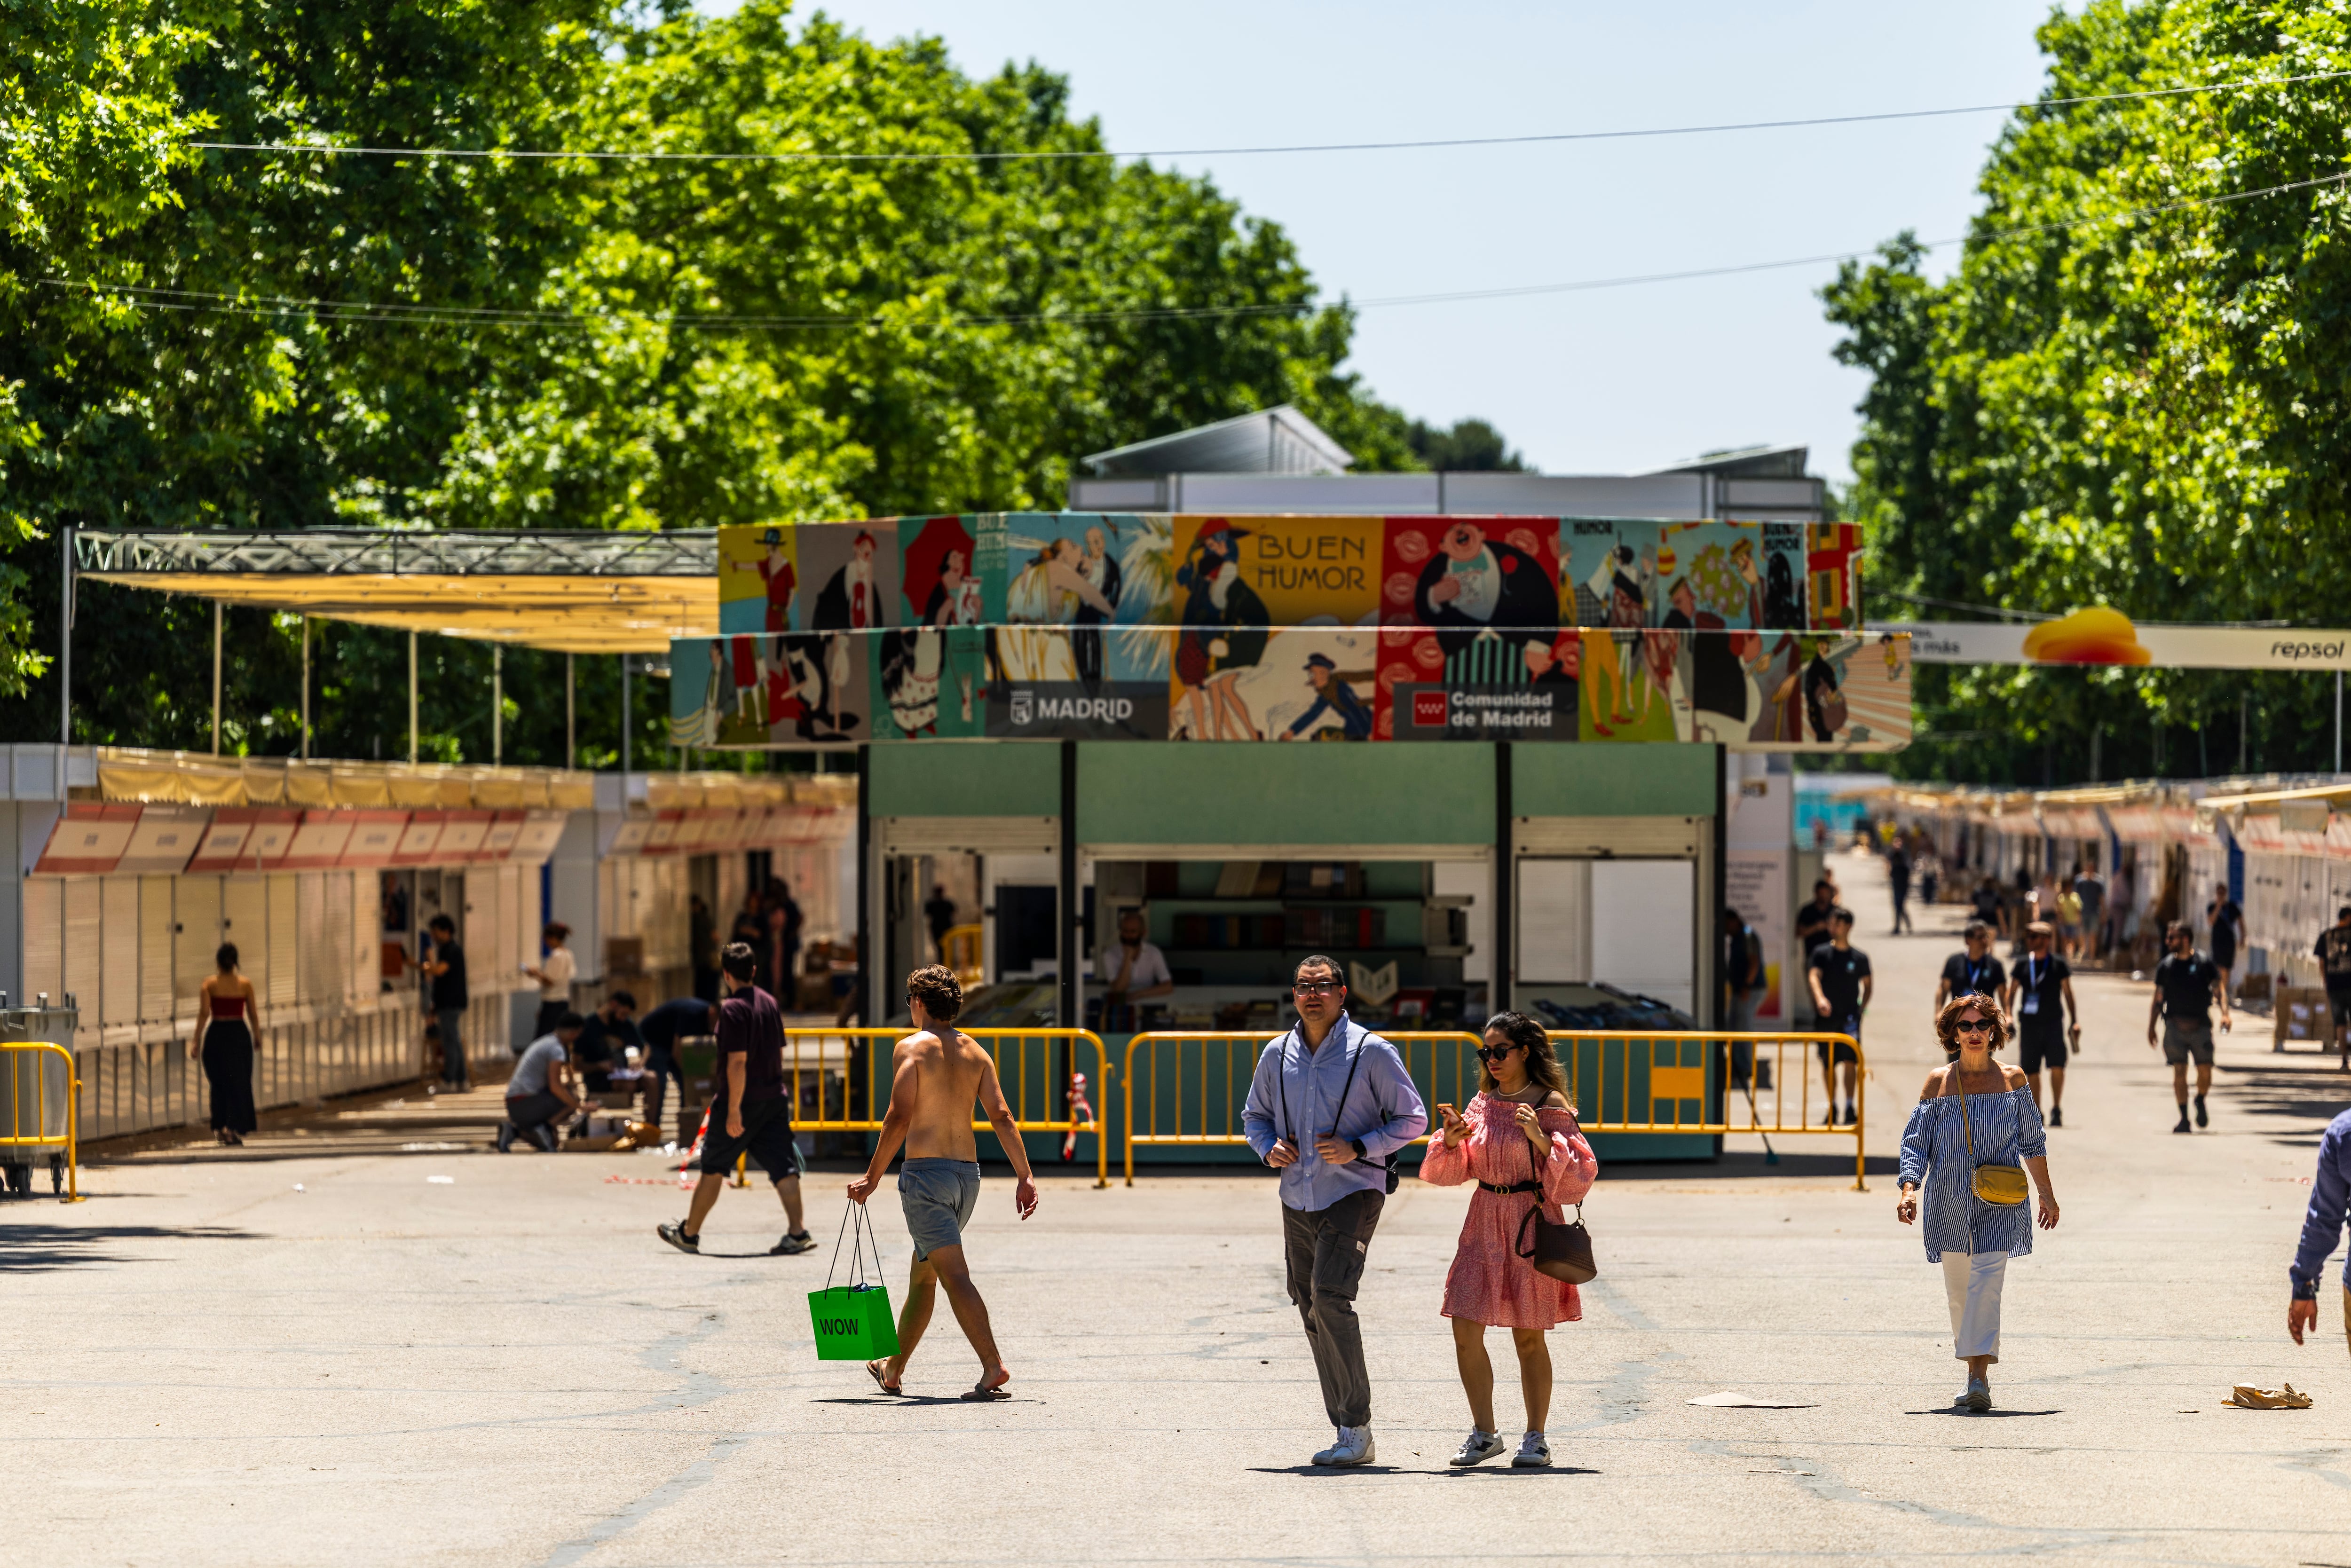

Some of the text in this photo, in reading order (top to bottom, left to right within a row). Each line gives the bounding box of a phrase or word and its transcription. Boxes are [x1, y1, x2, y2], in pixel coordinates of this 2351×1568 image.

[1573, 520, 1612, 535] HUMOR
[1258, 535, 1365, 560] BUEN
[1764, 537, 1800, 552] HUMOR
[1258, 566, 1366, 590] HUMOR
[2271, 639, 2345, 661] repsol
[1451, 691, 1553, 707] Comunidad
[1038, 697, 1134, 724] MADRID
[1451, 710, 1552, 726] de Madrid
[819, 1318, 858, 1335] WOW
